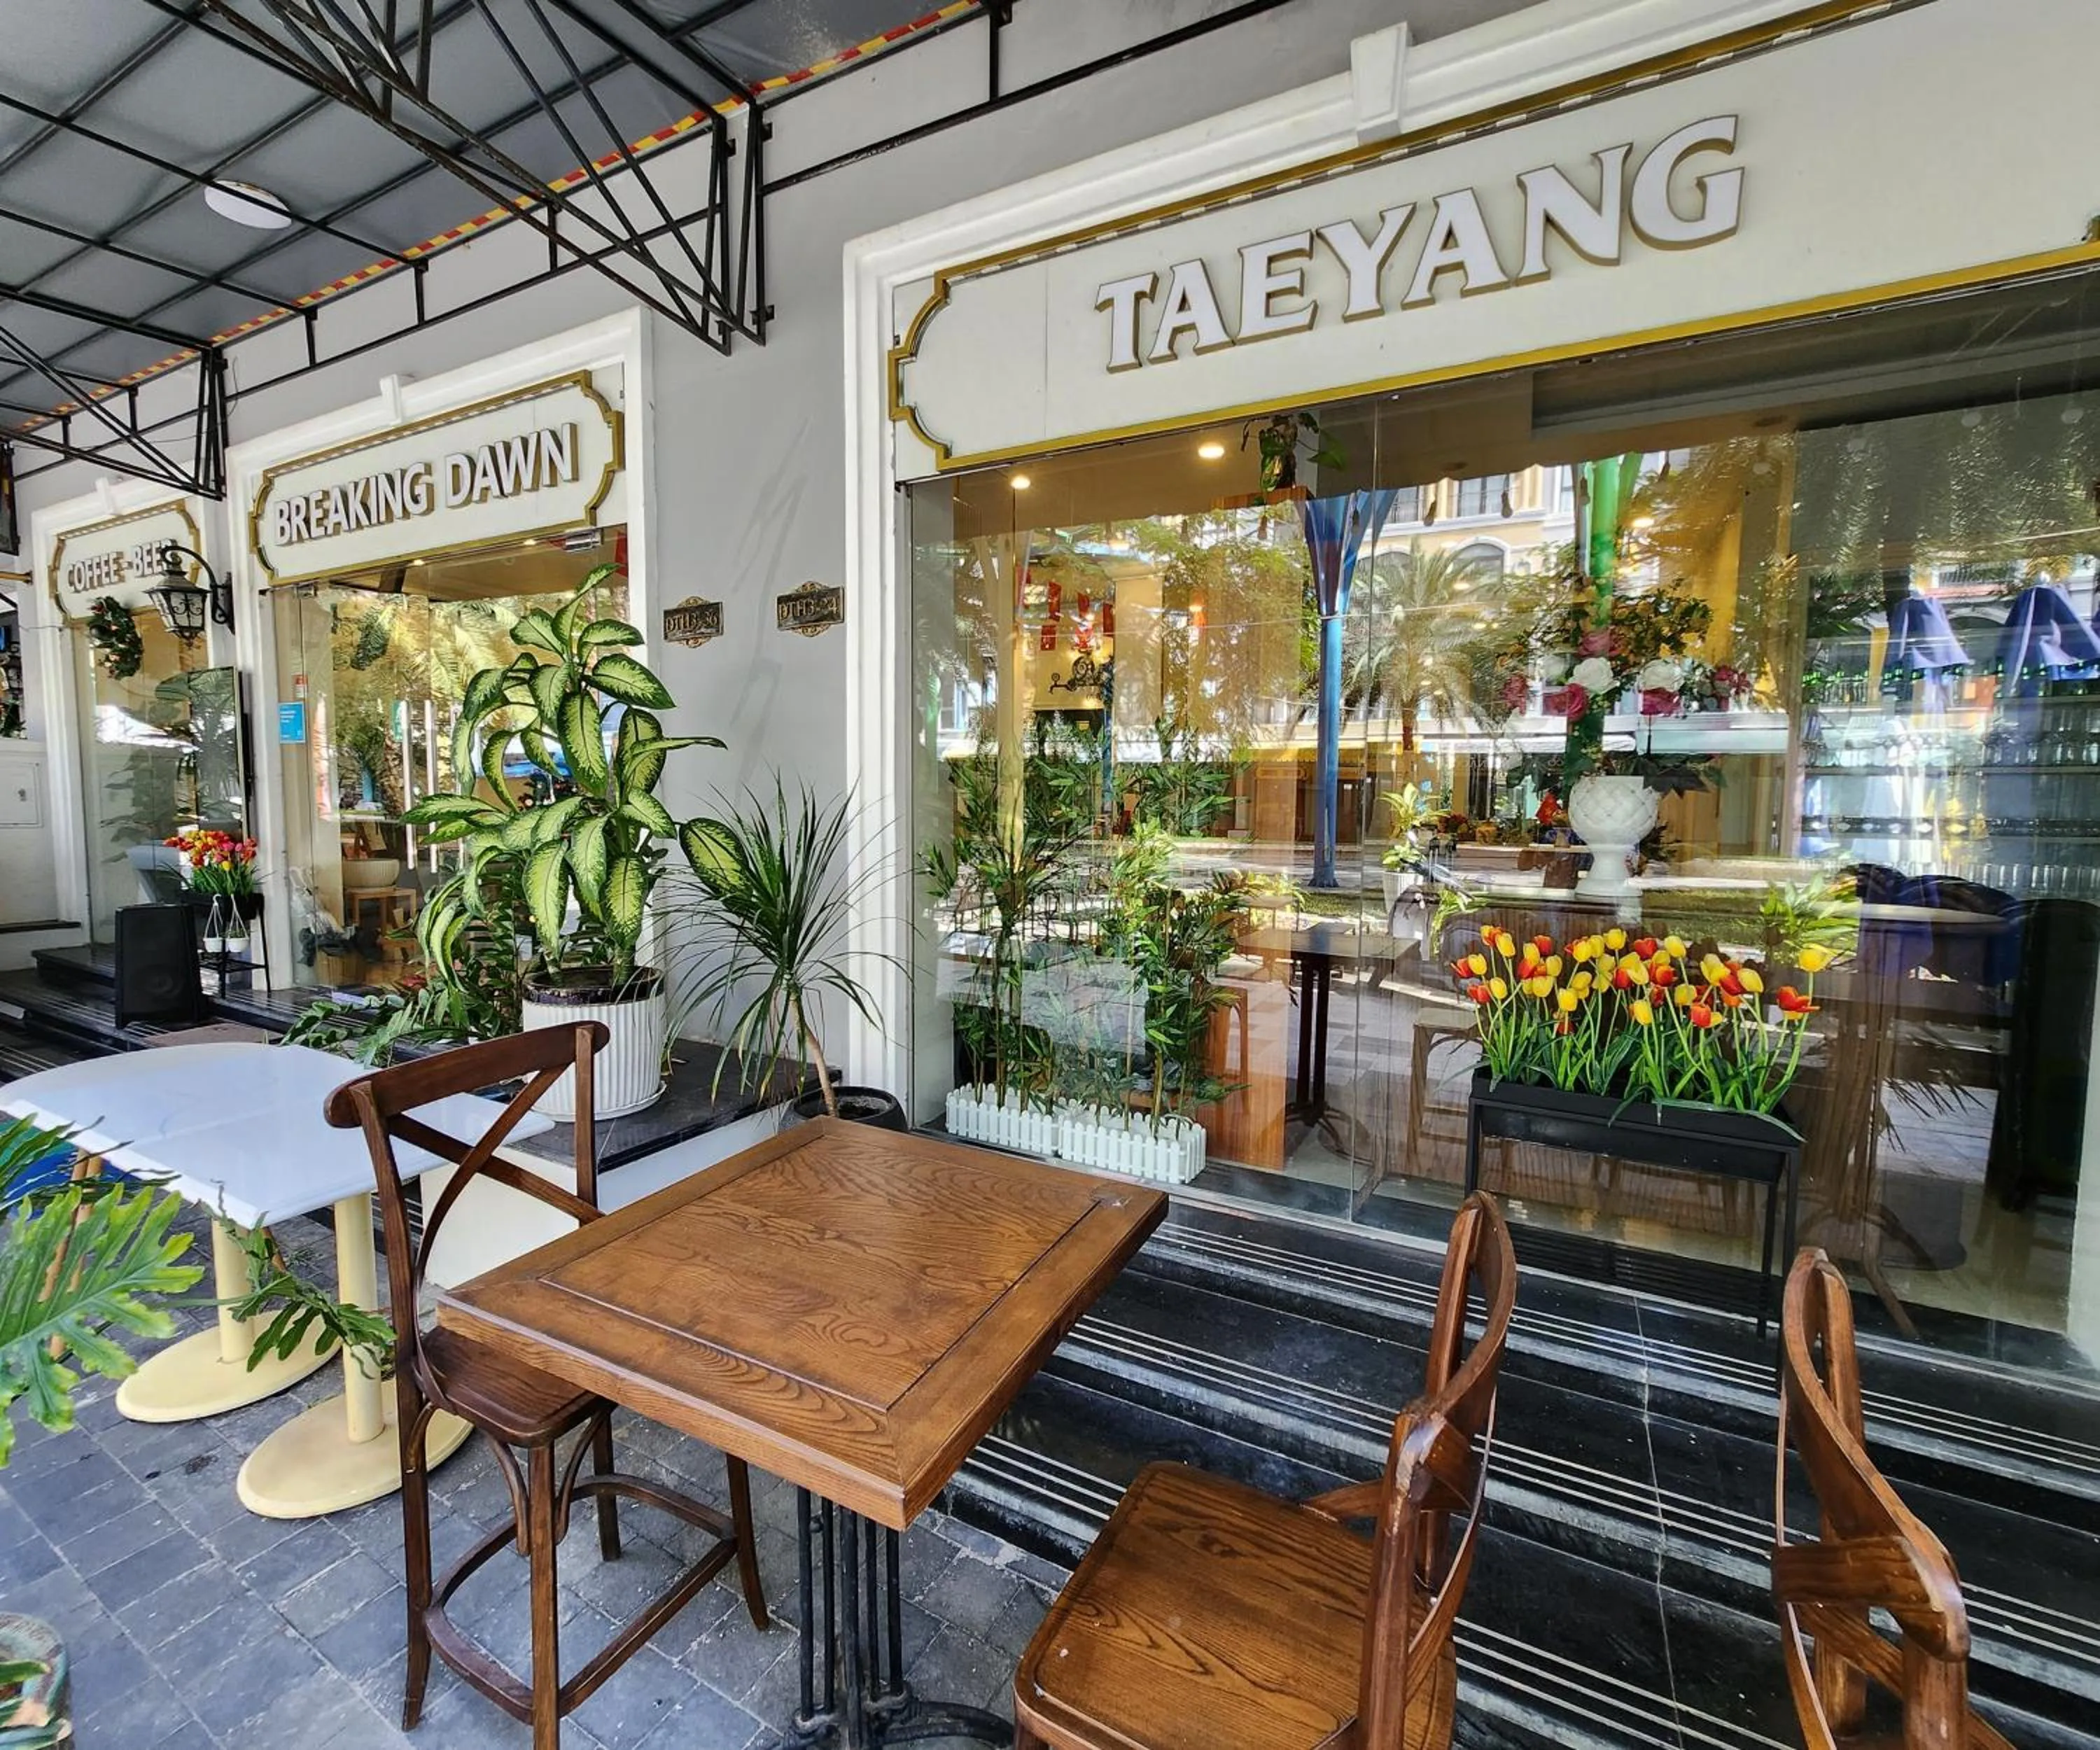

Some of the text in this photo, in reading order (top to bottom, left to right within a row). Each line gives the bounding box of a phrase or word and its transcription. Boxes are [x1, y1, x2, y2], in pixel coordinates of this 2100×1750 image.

[1095, 115, 1744, 372] TAEYANG
[275, 423, 579, 546] BREAKING DAWN
[68, 552, 125, 592] COFFEE
